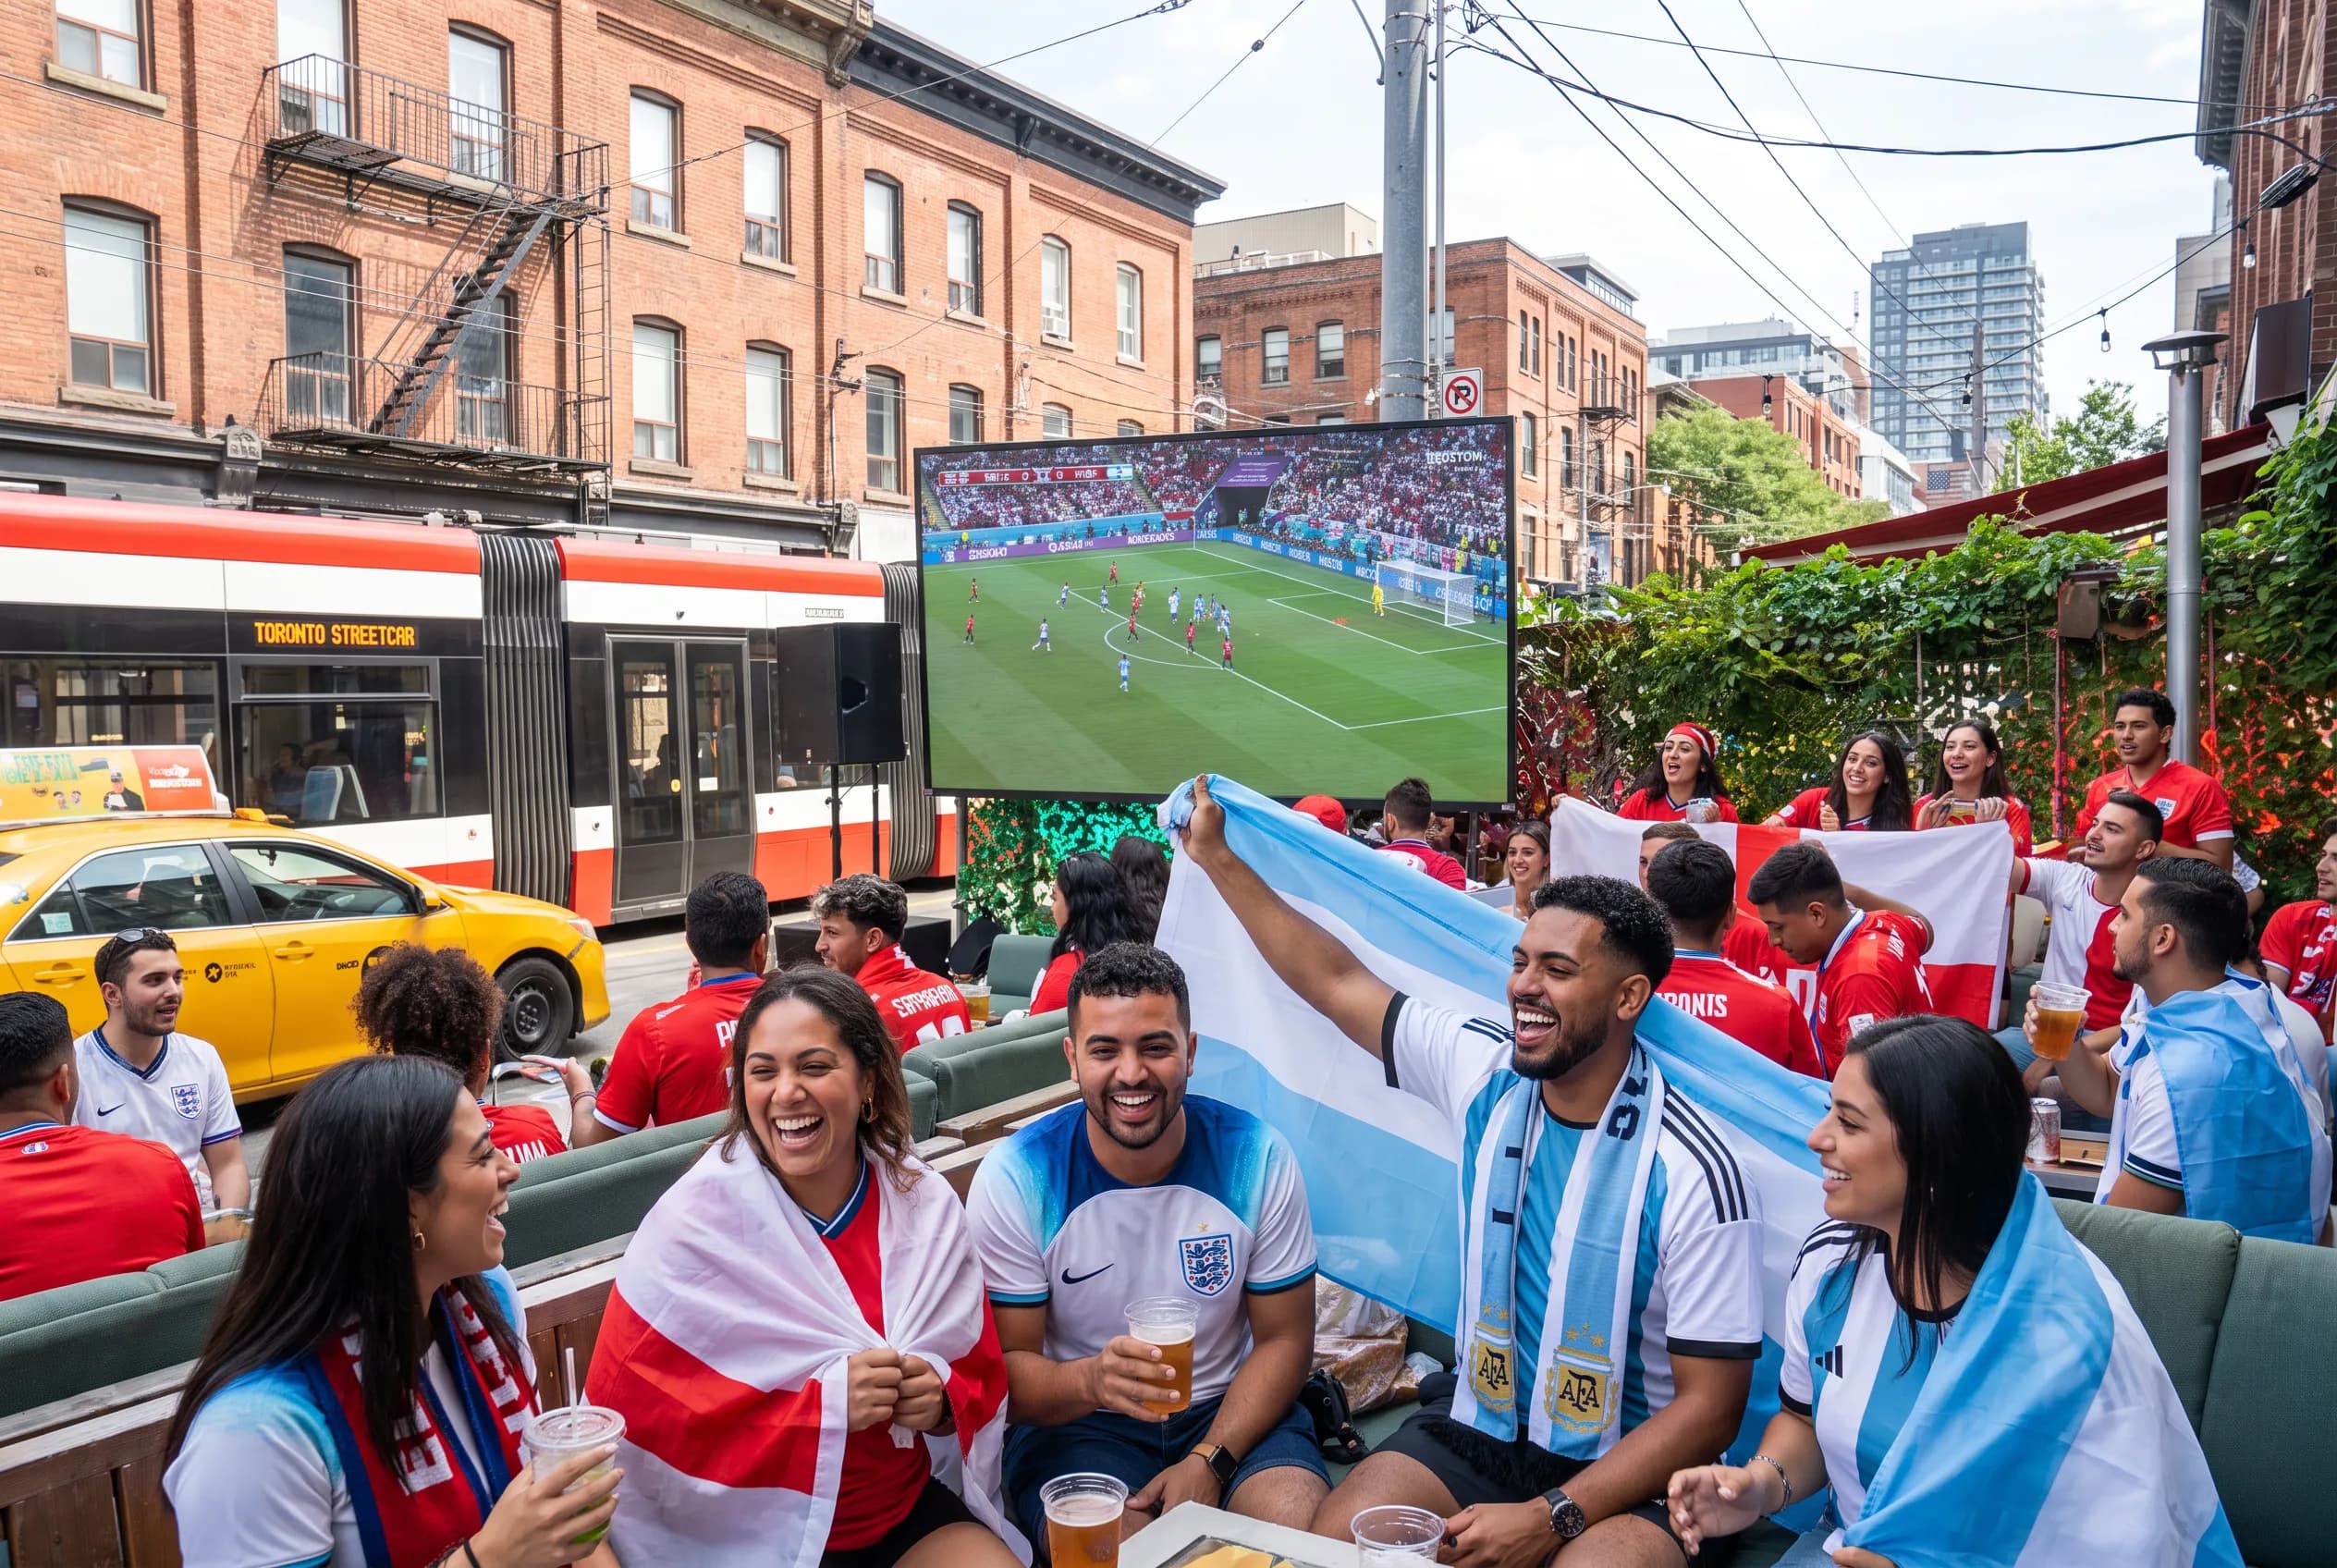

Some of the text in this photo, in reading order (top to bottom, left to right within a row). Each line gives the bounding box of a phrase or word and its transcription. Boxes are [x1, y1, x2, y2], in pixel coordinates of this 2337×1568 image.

[254, 622, 415, 646] TORONTO STREETCAR
[1478, 1346, 1510, 1391] AFA
[1559, 1369, 1600, 1414] AFA
